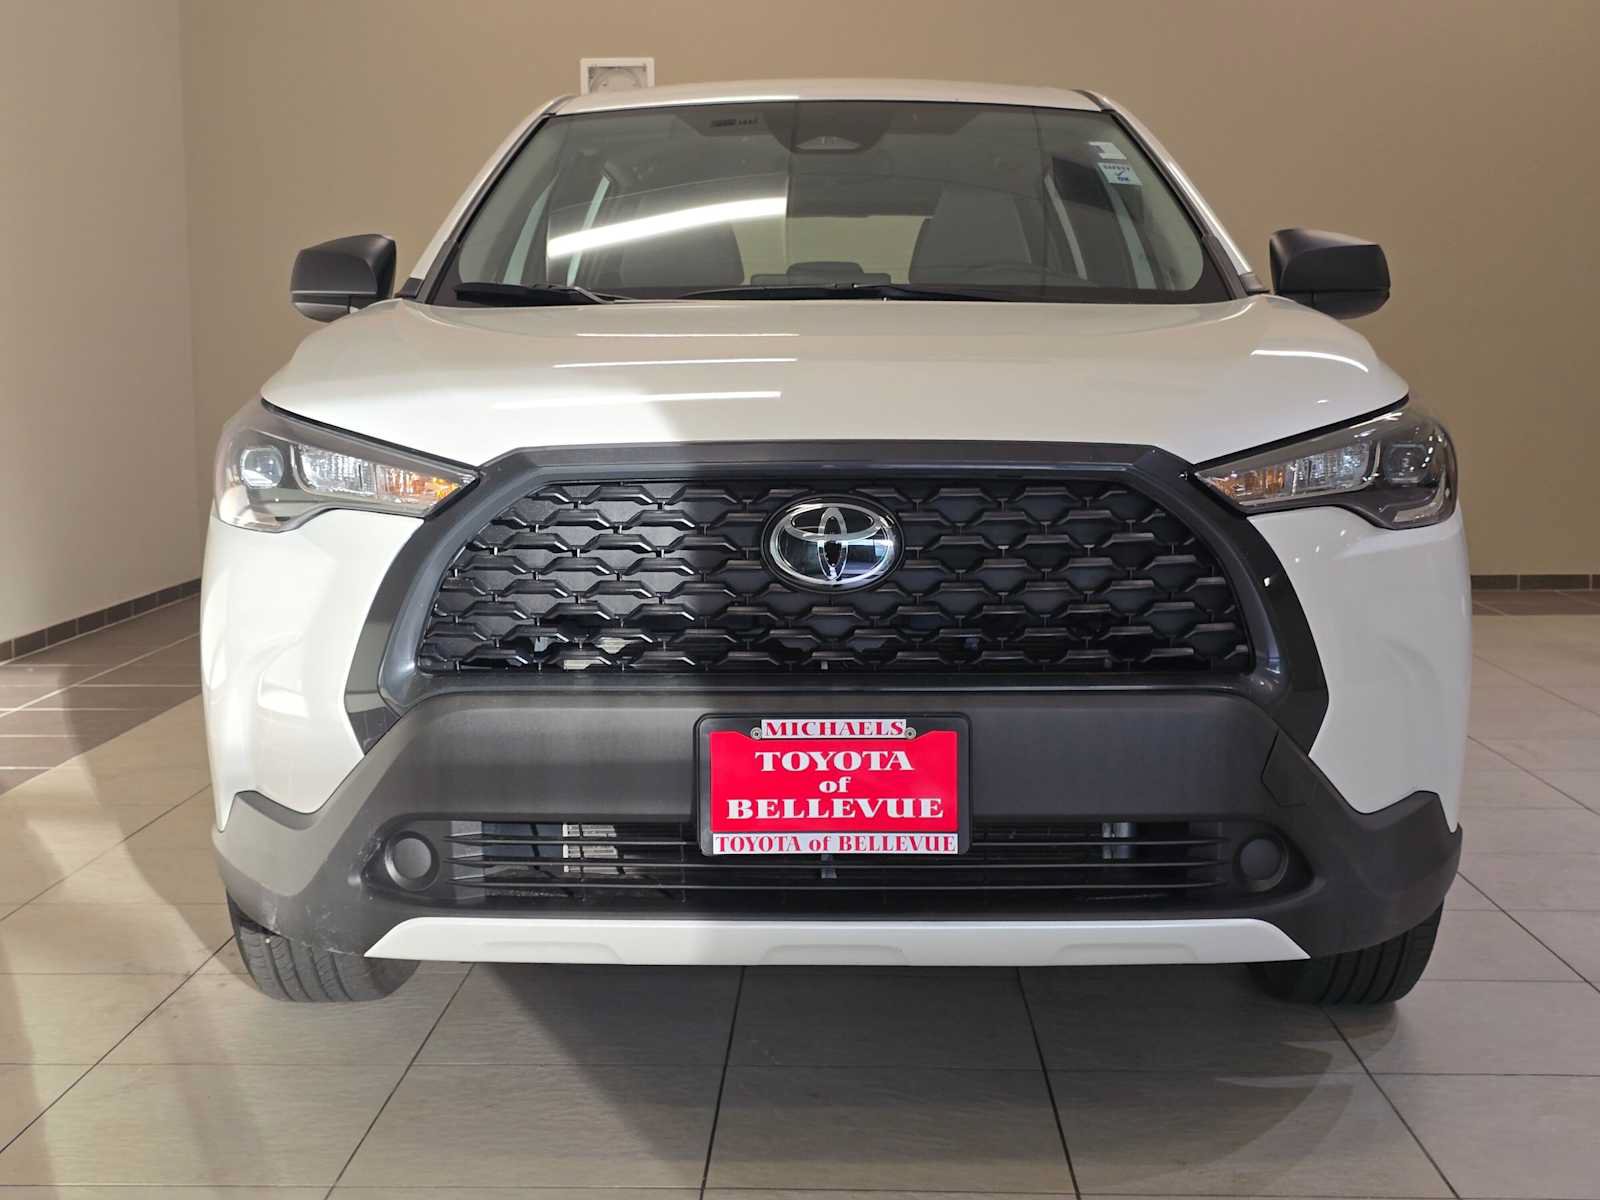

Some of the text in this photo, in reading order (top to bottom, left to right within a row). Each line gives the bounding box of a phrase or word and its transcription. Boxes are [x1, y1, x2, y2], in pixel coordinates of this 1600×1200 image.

[764, 721, 905, 737] MICHAELS
[755, 751, 914, 771] TOYOTA
[819, 776, 852, 793] of
[726, 798, 944, 819] BELLEVUE
[715, 836, 956, 852] TOYOTA of BELLEVUE
